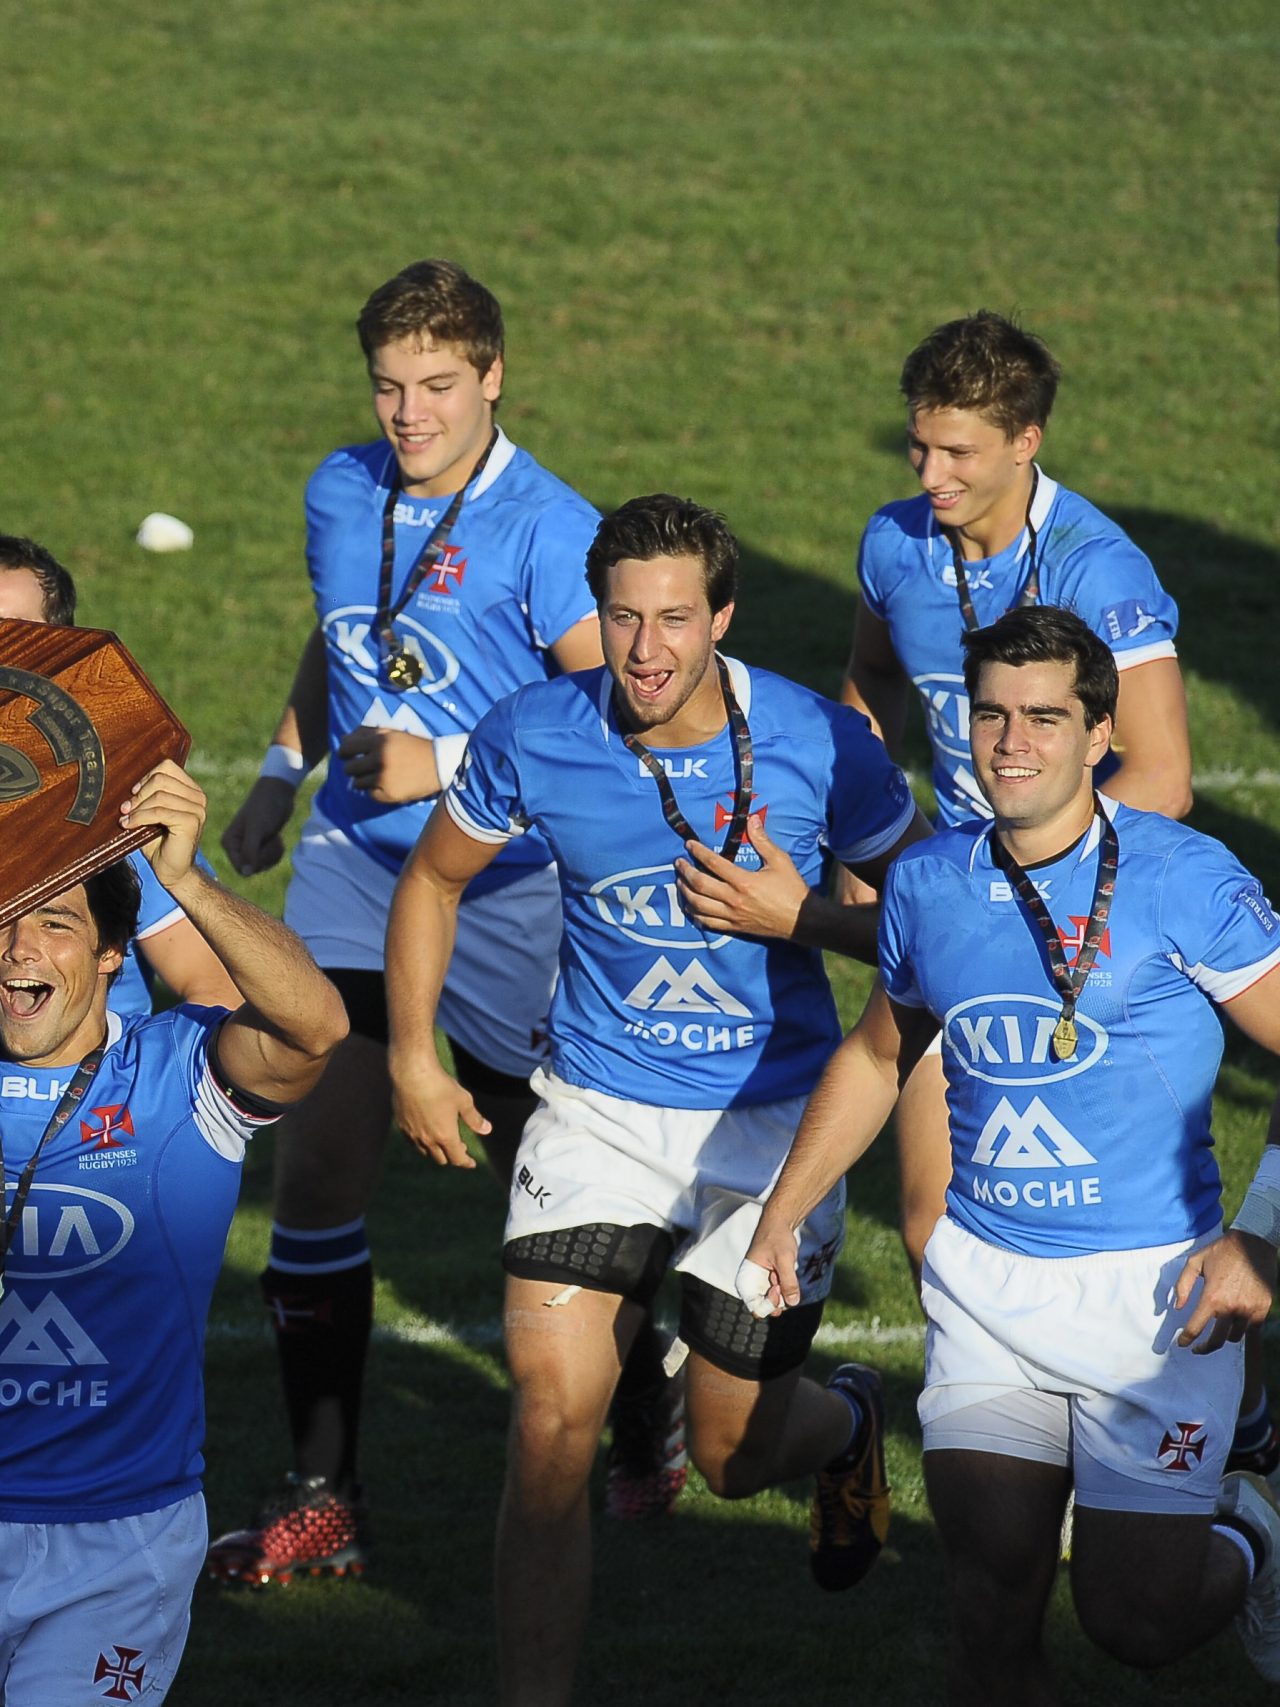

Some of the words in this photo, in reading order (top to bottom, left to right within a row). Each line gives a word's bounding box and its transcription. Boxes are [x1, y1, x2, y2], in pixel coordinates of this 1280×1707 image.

[393, 503, 439, 528] BLK
[335, 620, 437, 681] KA
[623, 1020, 754, 1052] MOCHE
[78, 1149, 137, 1162] BELENENSES
[78, 1160, 115, 1170] RUGBY
[116, 1157, 137, 1168] 1928
[518, 1163, 552, 1210] BLK
[972, 1176, 1103, 1208] MOCHE
